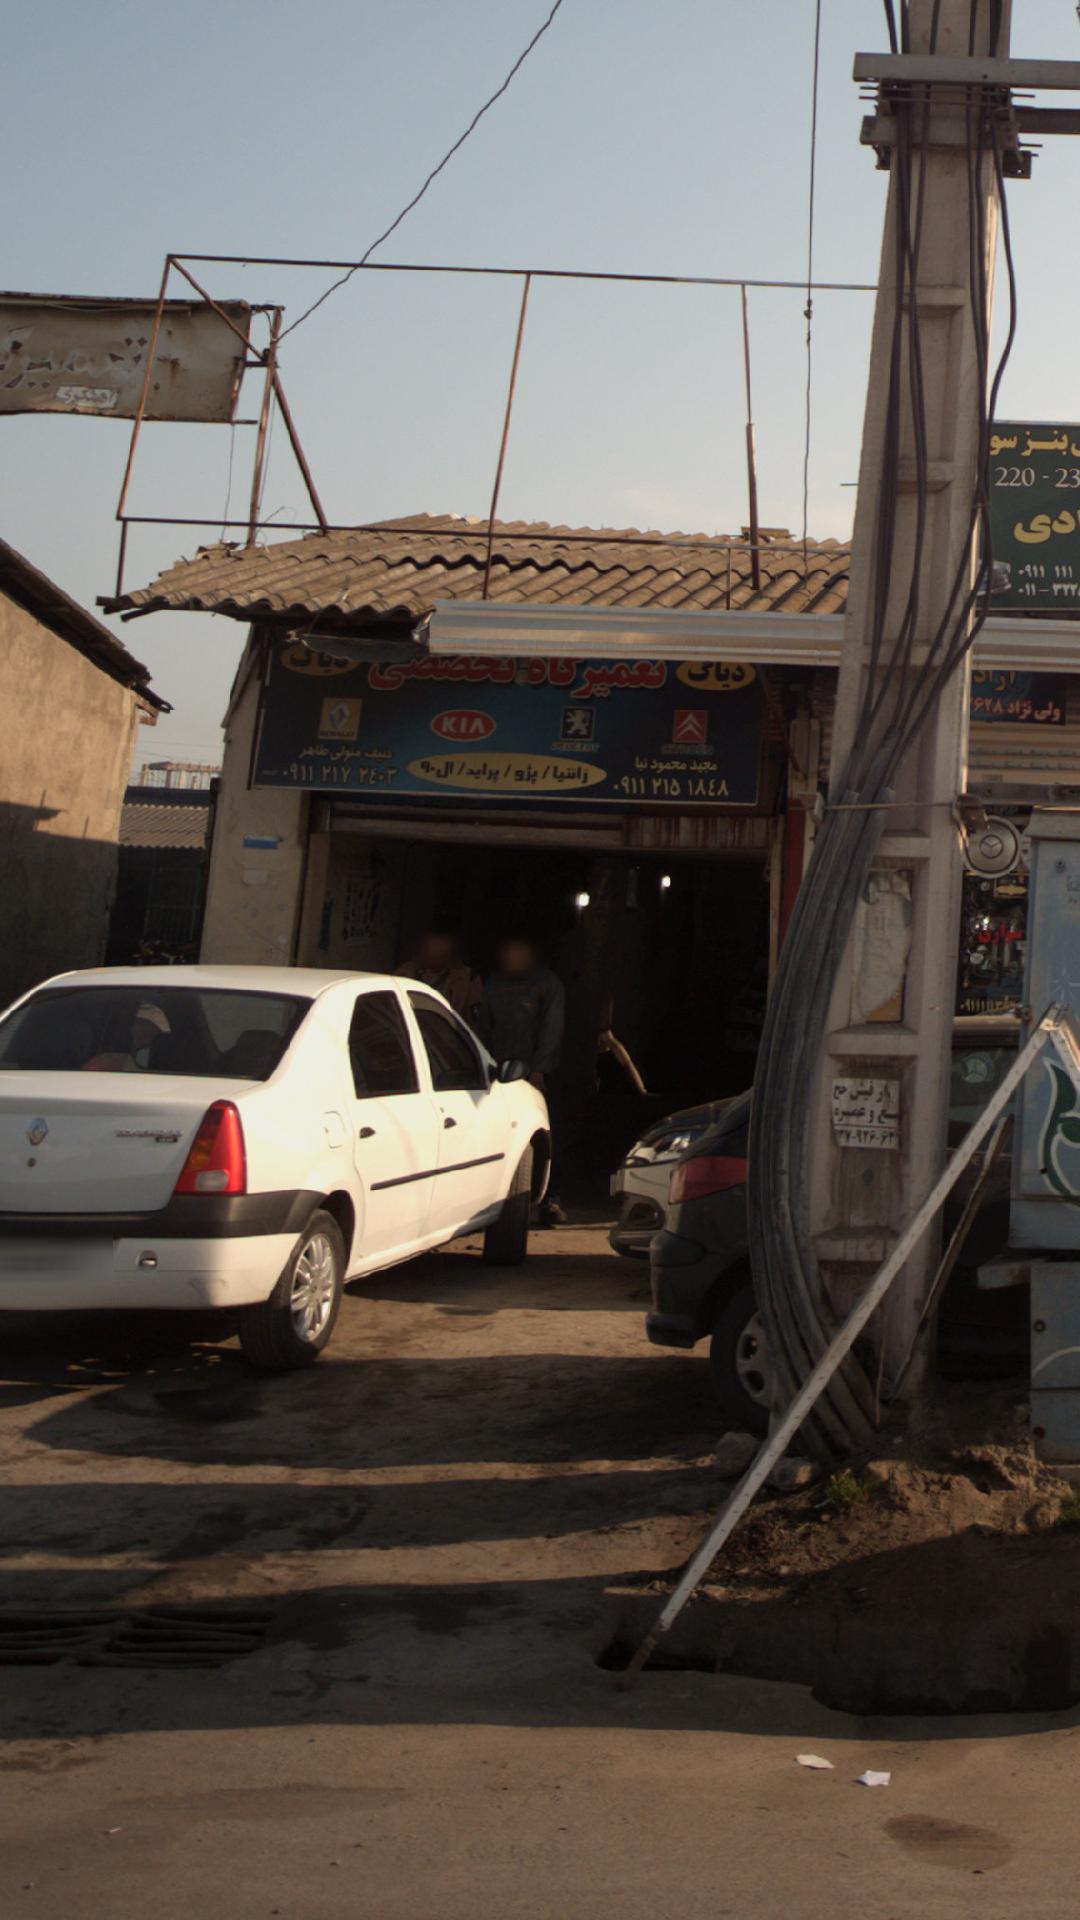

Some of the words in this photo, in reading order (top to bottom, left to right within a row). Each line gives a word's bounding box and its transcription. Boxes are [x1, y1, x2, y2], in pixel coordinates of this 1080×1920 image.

[994, 466, 1036, 487] 220
[1055, 467, 1080, 488] 23
[441, 716, 485, 735] KIA
[612, 775, 646, 794] ۰۹۱۱
